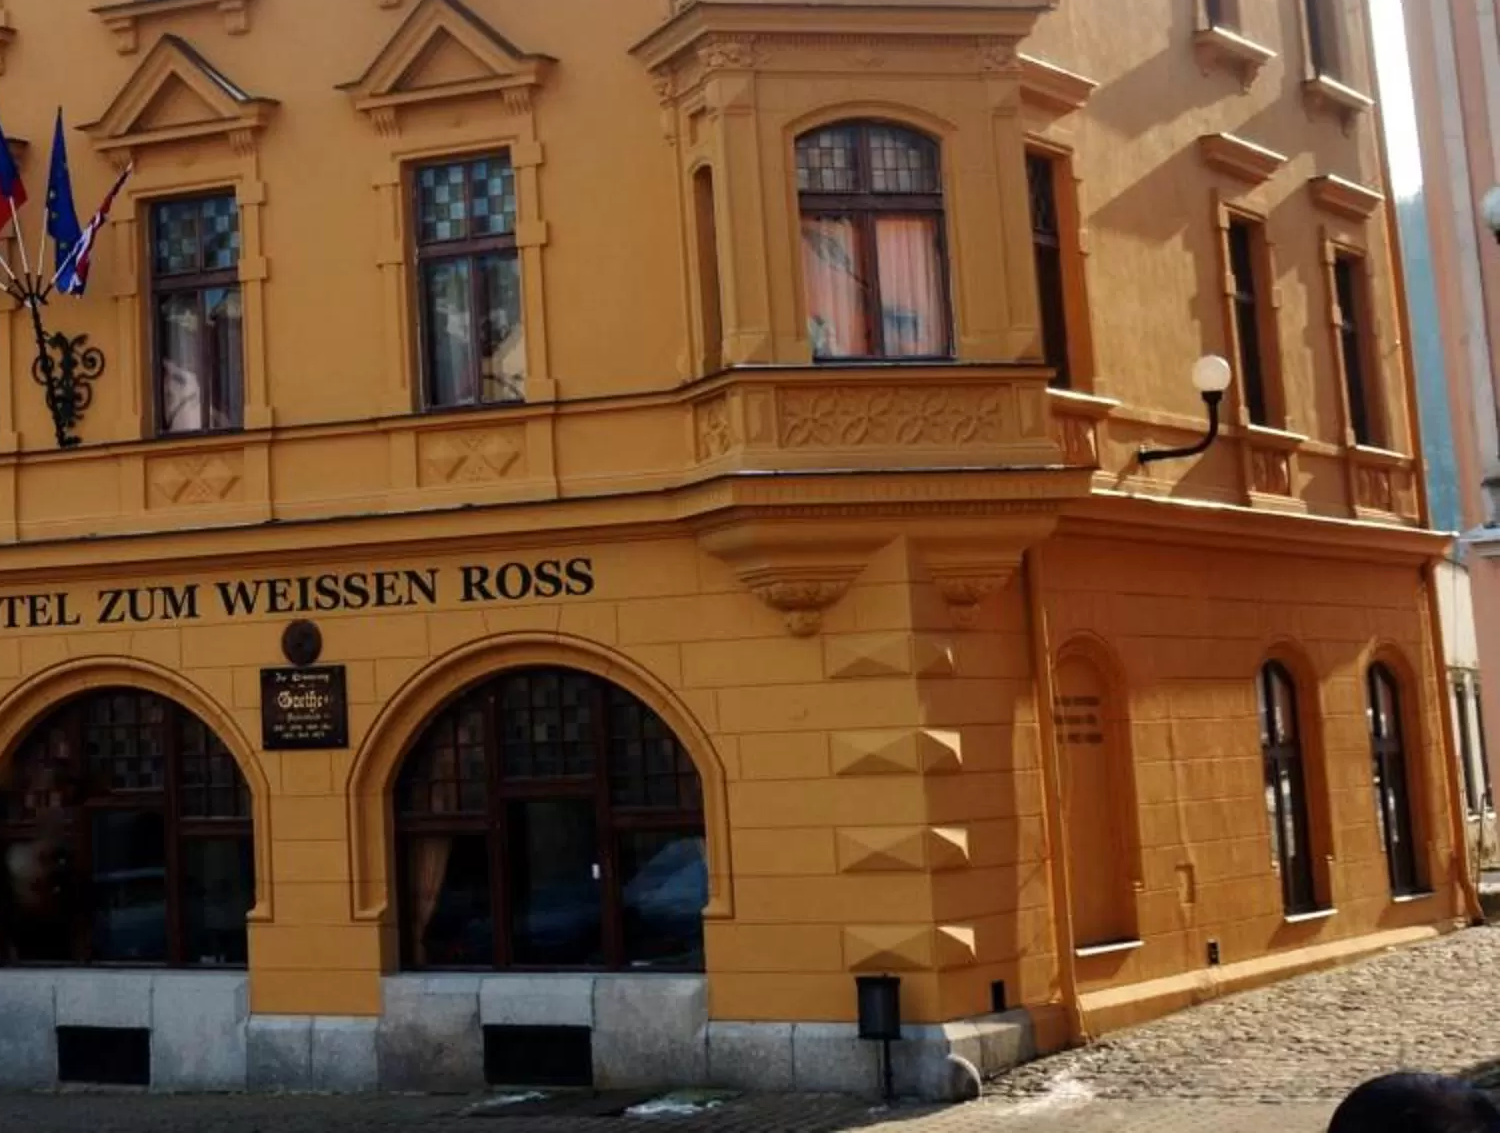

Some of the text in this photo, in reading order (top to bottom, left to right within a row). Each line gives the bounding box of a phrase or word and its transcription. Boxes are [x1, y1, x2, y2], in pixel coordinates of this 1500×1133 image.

[97, 582, 199, 624] ZUM
[215, 567, 440, 618] WEISSEN
[459, 557, 596, 603] ROSS
